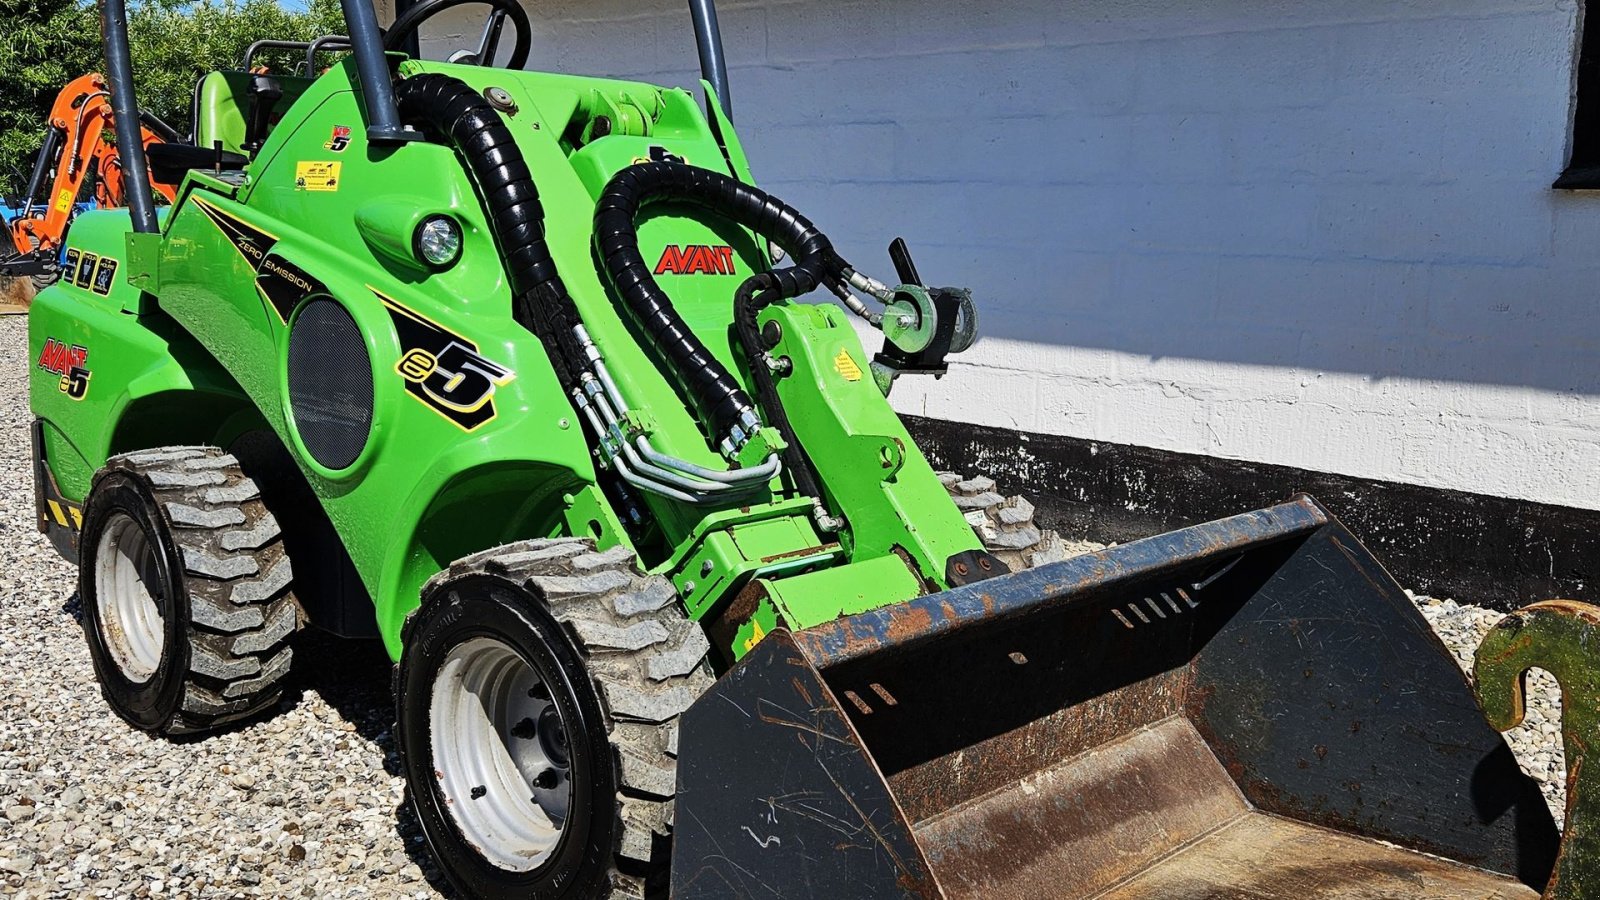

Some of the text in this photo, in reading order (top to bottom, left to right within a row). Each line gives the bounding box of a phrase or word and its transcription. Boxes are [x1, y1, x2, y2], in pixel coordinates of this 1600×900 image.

[238, 241, 312, 292] ZERO EMISSION
[653, 245, 736, 275] AVANT
[38, 337, 88, 376] AVANT
[396, 341, 516, 411] e5
